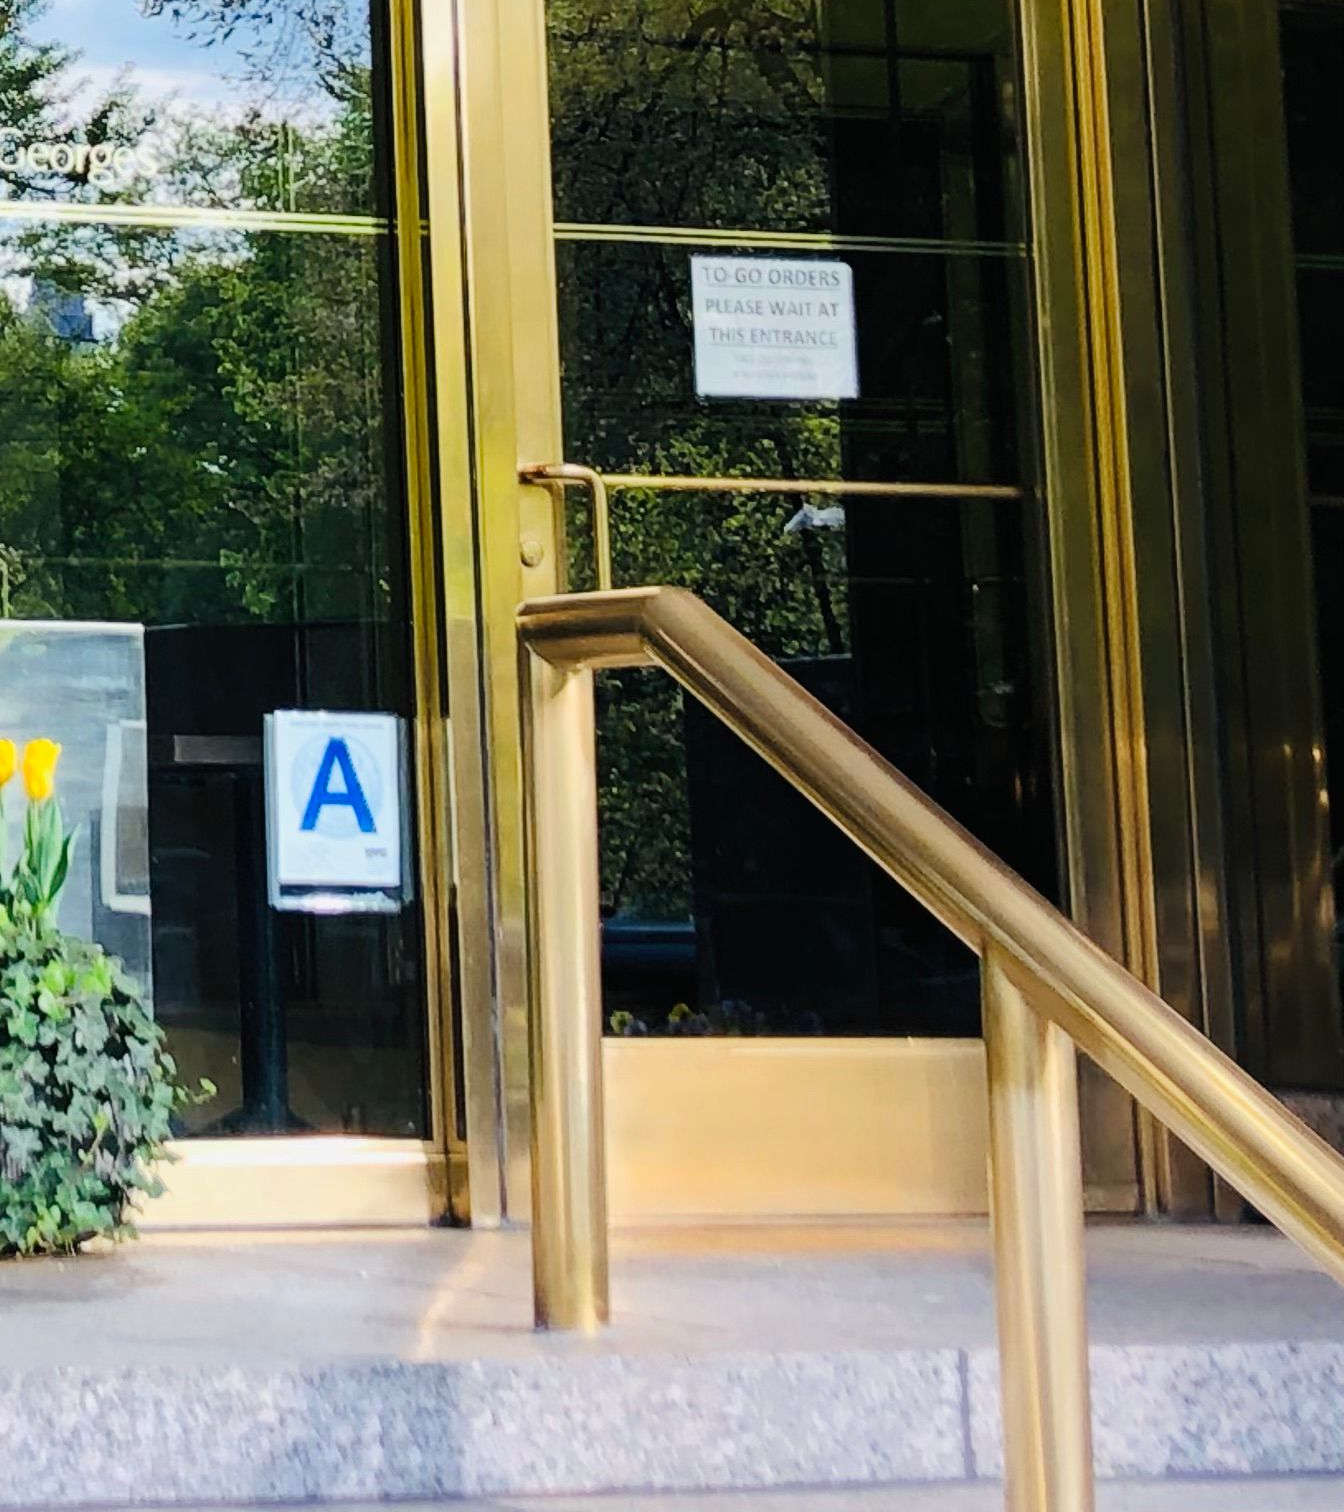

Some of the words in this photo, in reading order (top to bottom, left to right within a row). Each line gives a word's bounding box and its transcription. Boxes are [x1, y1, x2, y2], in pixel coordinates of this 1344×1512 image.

[768, 268, 841, 287] ORDERS
[704, 297, 763, 316] PLEASE
[768, 299, 812, 317] WAIT
[817, 301, 840, 318] AT
[709, 325, 745, 344] THIS
[750, 328, 838, 346] ENTRANCE
[300, 736, 377, 834] A
